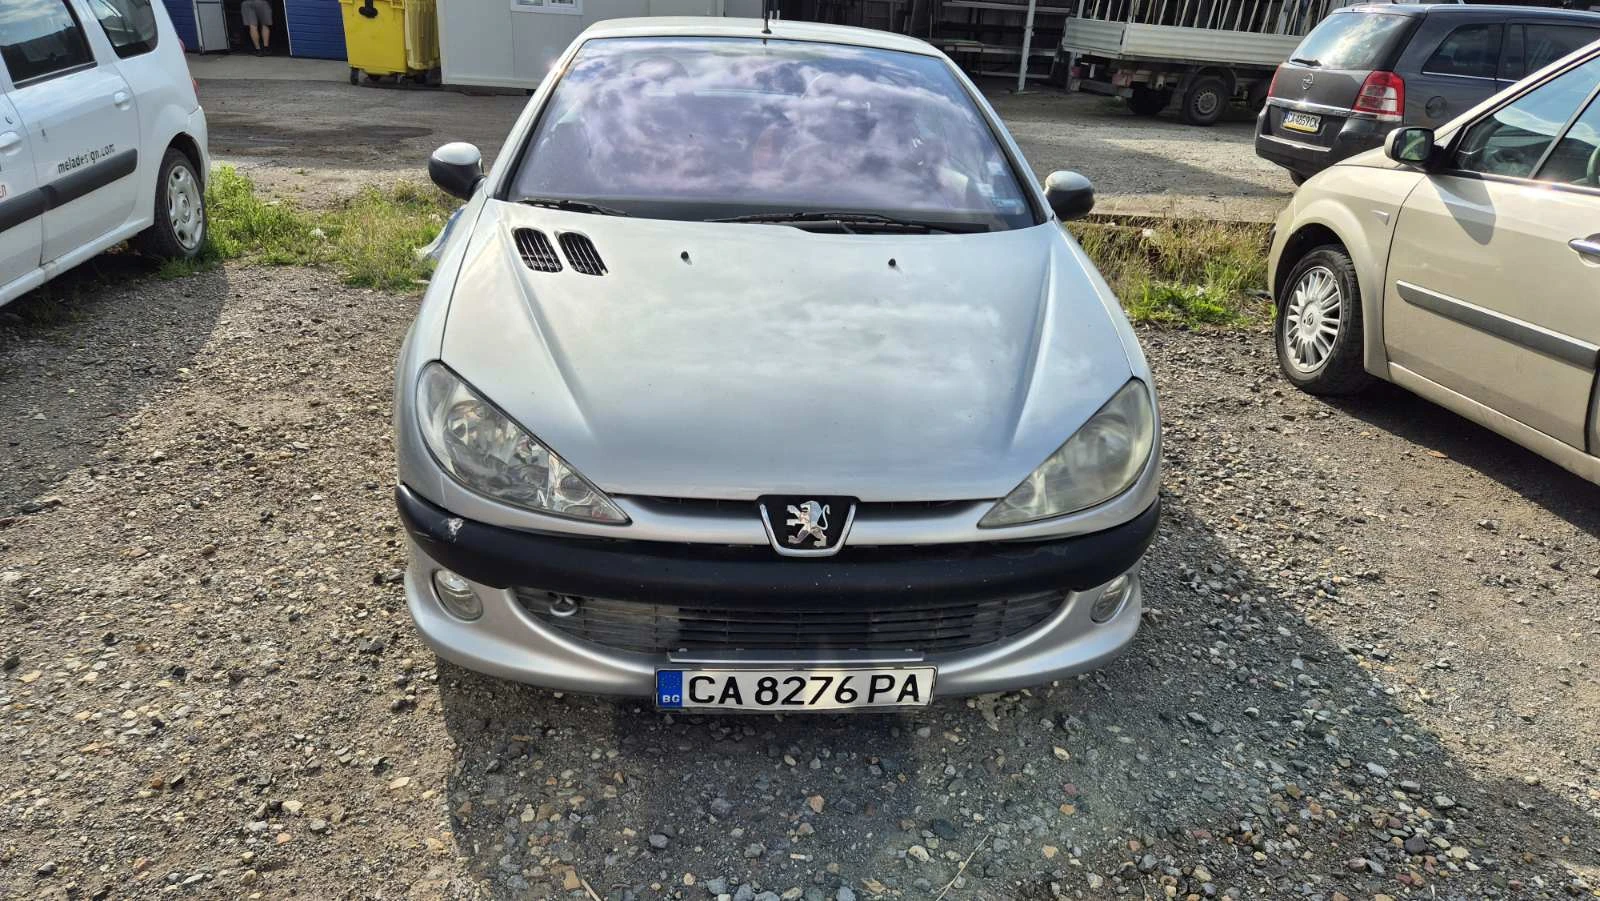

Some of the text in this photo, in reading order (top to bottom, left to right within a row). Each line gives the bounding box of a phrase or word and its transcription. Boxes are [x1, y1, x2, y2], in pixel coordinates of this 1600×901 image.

[57, 144, 115, 174] meladesign.com
[662, 694, 681, 703] BG
[689, 673, 920, 706] CA 8276 PA
